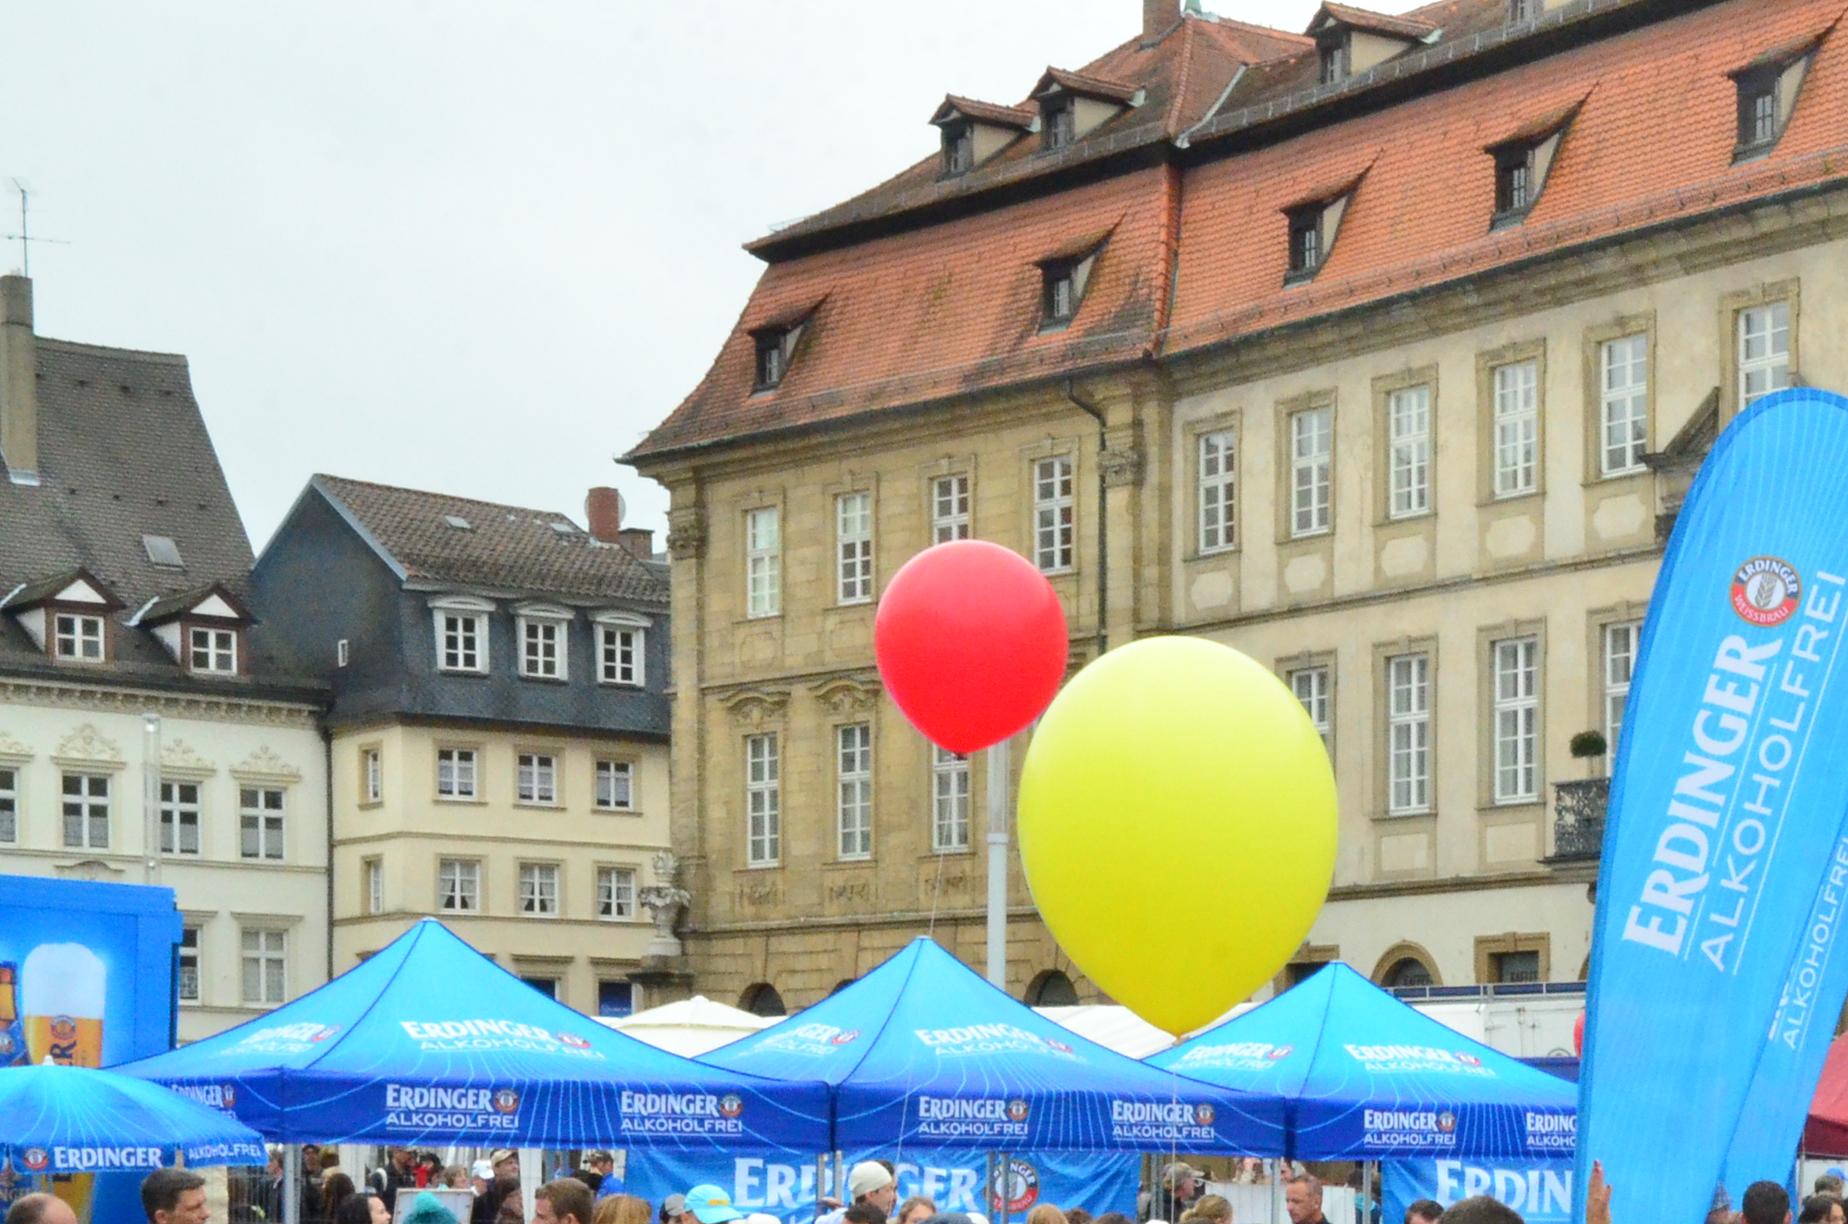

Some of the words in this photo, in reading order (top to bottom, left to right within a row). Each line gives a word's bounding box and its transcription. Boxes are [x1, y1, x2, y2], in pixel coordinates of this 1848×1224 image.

[1738, 559, 1799, 595] ERDINGER
[1701, 570, 1847, 972] ALKOHOLFREI
[1622, 635, 1783, 957] ERDINGER
[401, 1018, 560, 1043] ERDINGER
[386, 1084, 495, 1112] ERDINGER
[621, 1090, 720, 1117] ERDINGER
[918, 1097, 1009, 1120] ERDINGER
[386, 1112, 518, 1129] ALKOHOLFREI
[1112, 1100, 1196, 1125] ERDINGER
[1364, 1109, 1439, 1132] ERDINGER
[621, 1117, 743, 1132] ALKOHOLFREI
[918, 1121, 1028, 1136] ALKOHOLFREI
[1112, 1126, 1215, 1139] ALKOHOLFREI
[1364, 1133, 1456, 1145] ALKOHOLFREI
[53, 1146, 163, 1170] ERDINGER
[188, 1143, 262, 1160] ALKOHOLFREI
